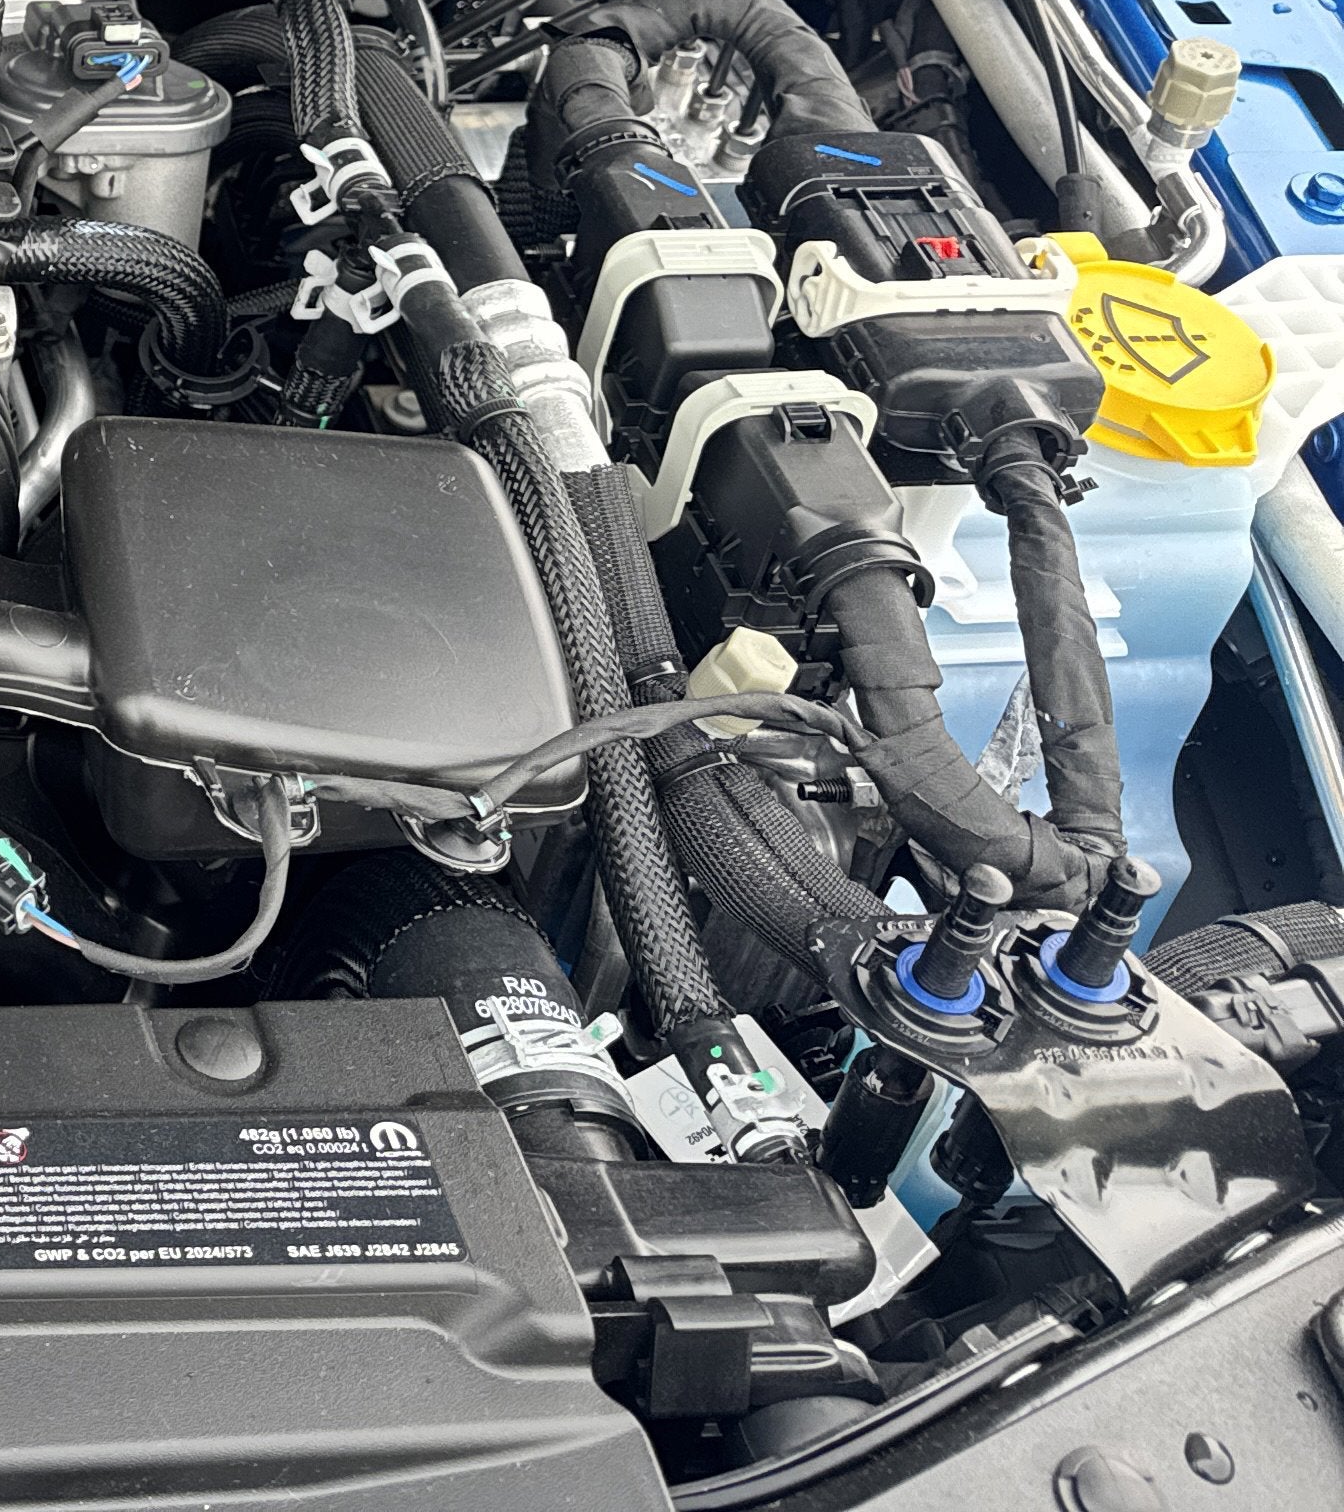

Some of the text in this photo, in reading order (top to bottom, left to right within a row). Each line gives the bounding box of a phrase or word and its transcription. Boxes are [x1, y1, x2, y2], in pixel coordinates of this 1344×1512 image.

[502, 976, 547, 997] RAD
[474, 995, 582, 1029] 6280782AD
[238, 1126, 360, 1143] 482g (1.060 lb)
[252, 1143, 285, 1155] CO2
[287, 1144, 305, 1156] eq
[306, 1142, 360, 1154] 0.00024
[34, 1249, 72, 1262] GWP
[77, 1249, 90, 1261] &
[92, 1248, 127, 1261] CO2
[129, 1250, 156, 1262] per
[158, 1247, 182, 1259] EU
[286, 1242, 461, 1258] SAE J639 J2842 J2845
